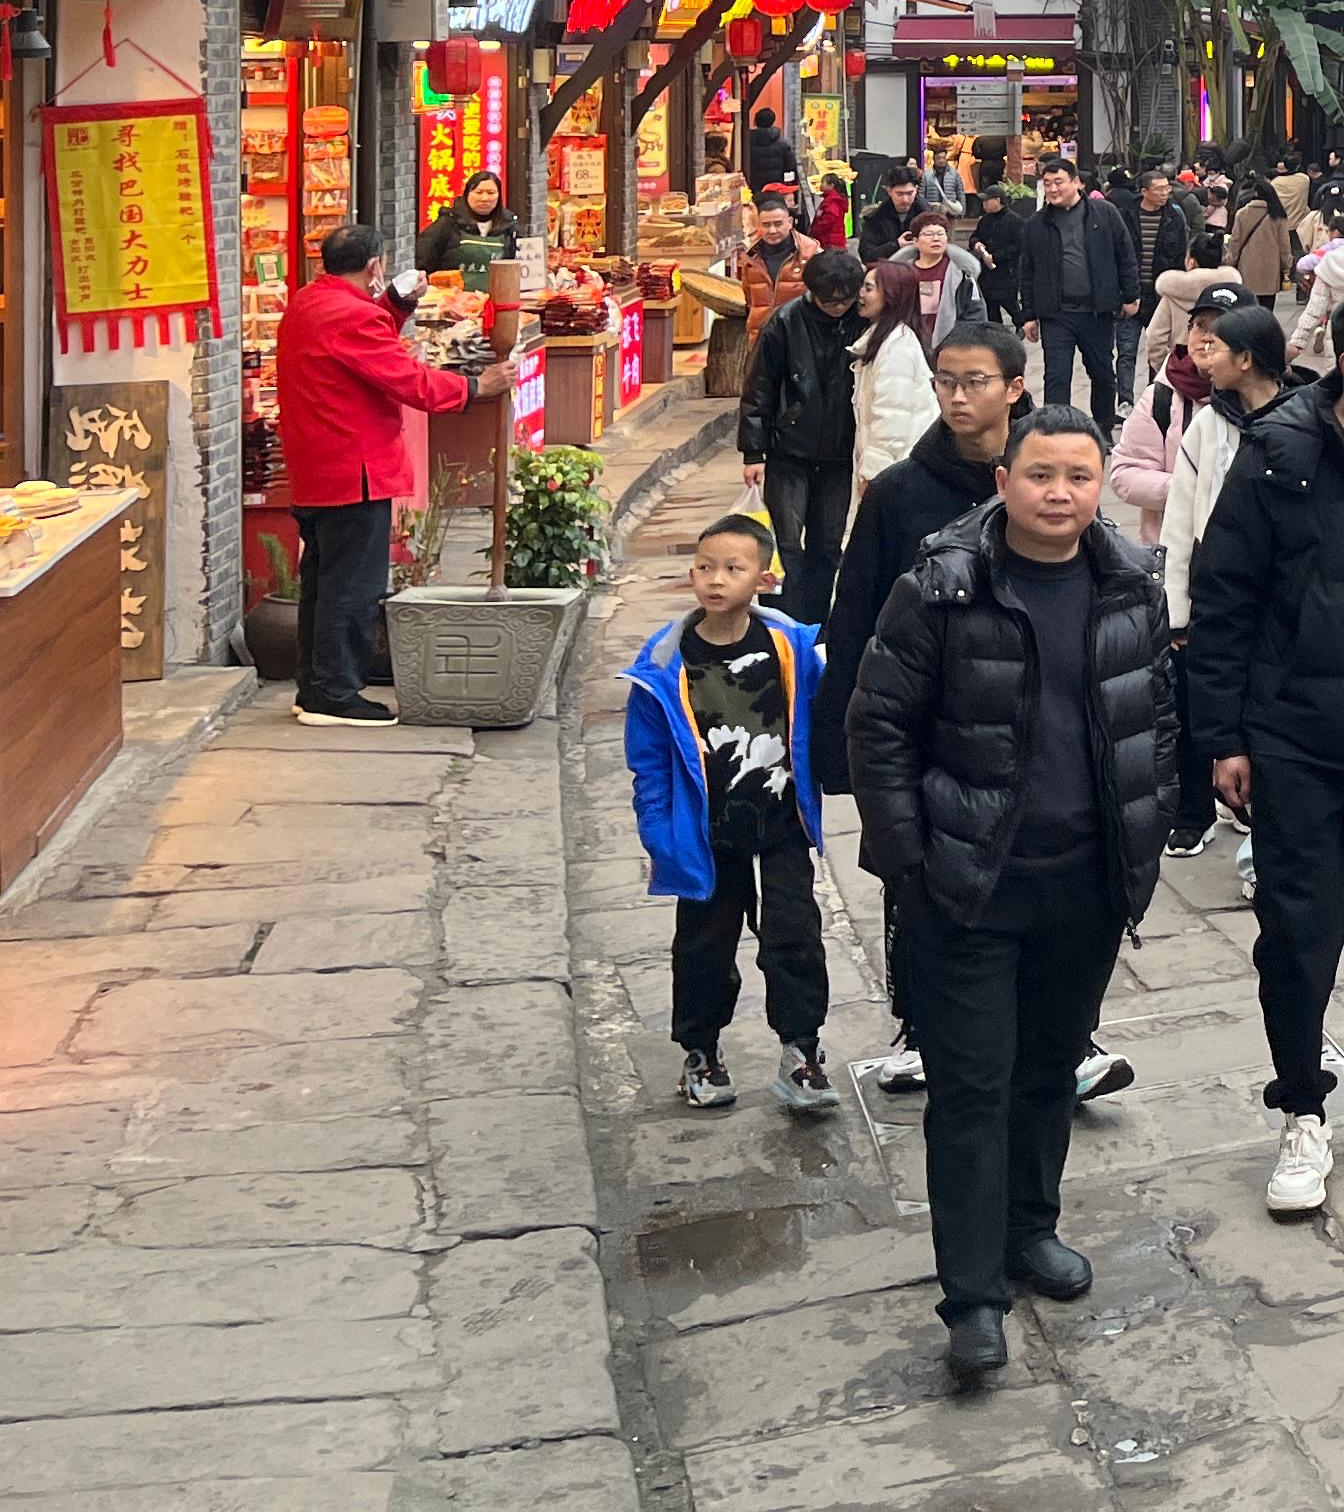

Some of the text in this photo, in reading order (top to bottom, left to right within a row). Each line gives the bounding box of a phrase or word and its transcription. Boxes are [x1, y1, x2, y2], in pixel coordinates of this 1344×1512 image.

[112, 124, 153, 301] 寻找巴国大力士
